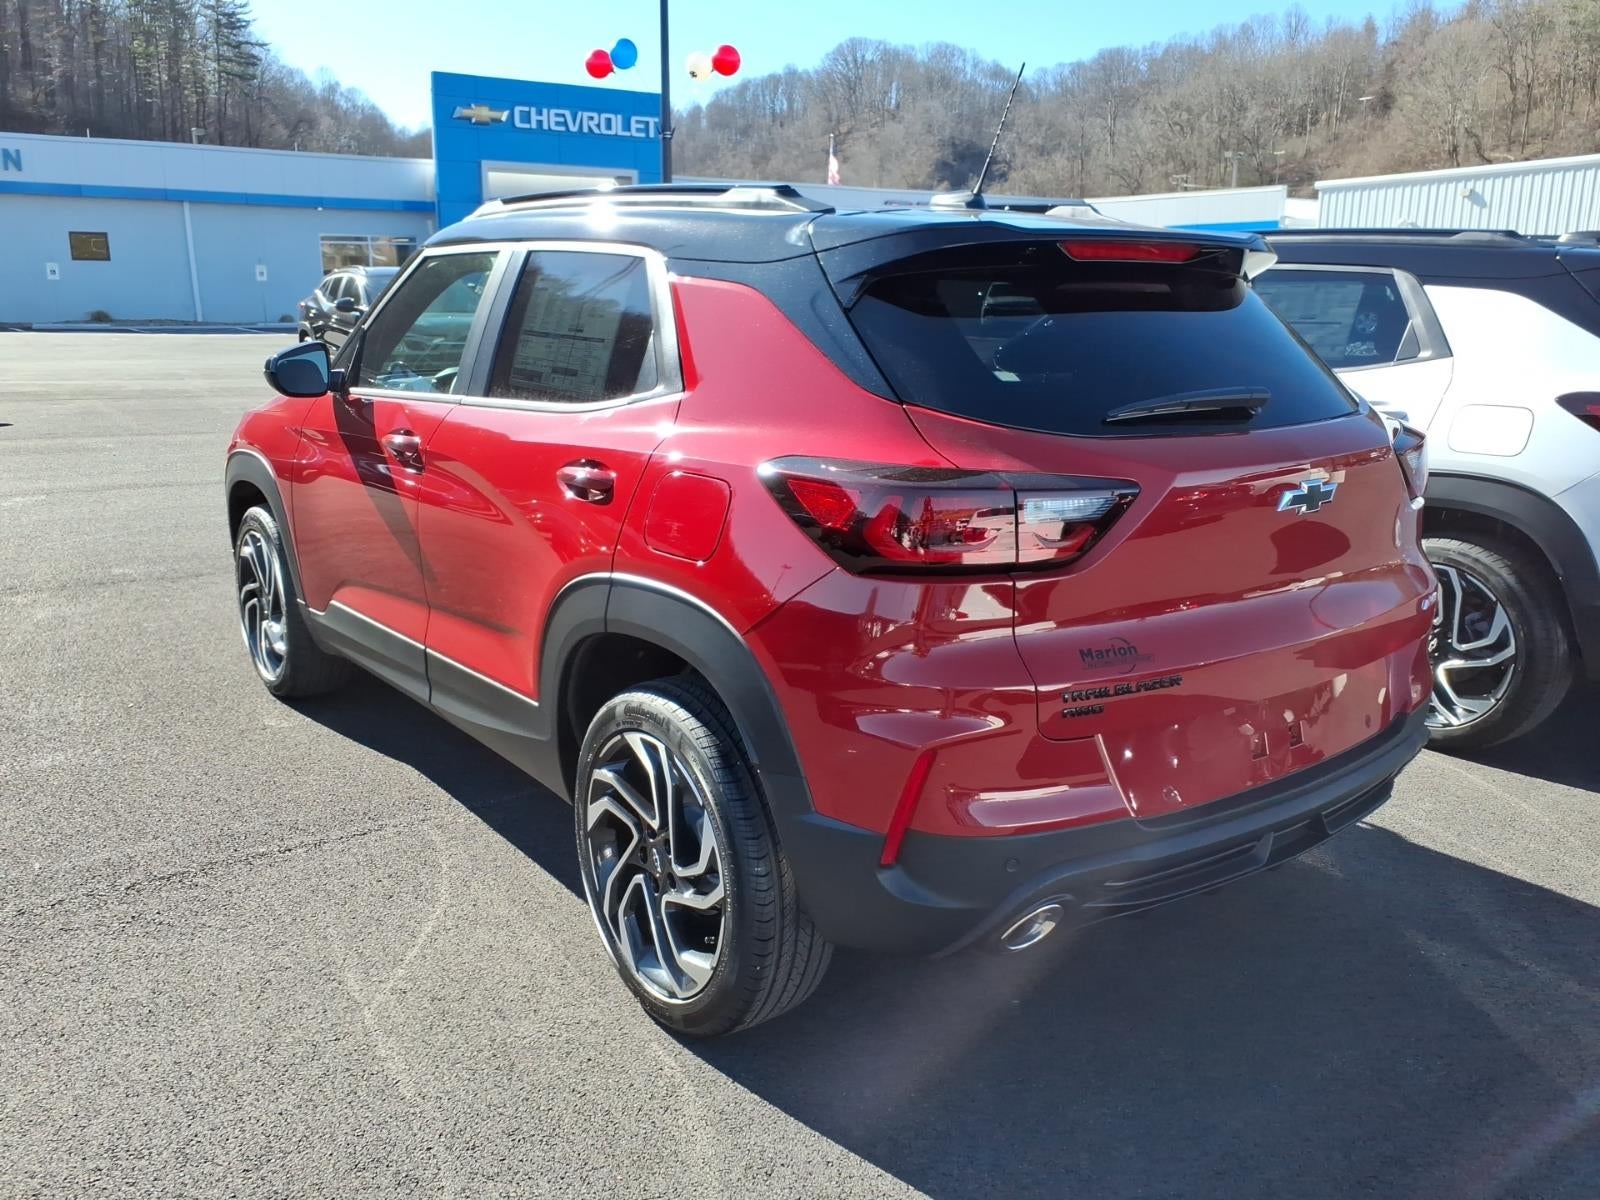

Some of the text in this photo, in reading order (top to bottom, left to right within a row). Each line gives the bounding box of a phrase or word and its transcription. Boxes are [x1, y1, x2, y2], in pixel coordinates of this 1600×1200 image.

[513, 105, 659, 138] CHEVROLET
[2, 148, 22, 171] N
[1079, 645, 1138, 663] Marion
[1062, 674, 1184, 703] TRAILBLAZER
